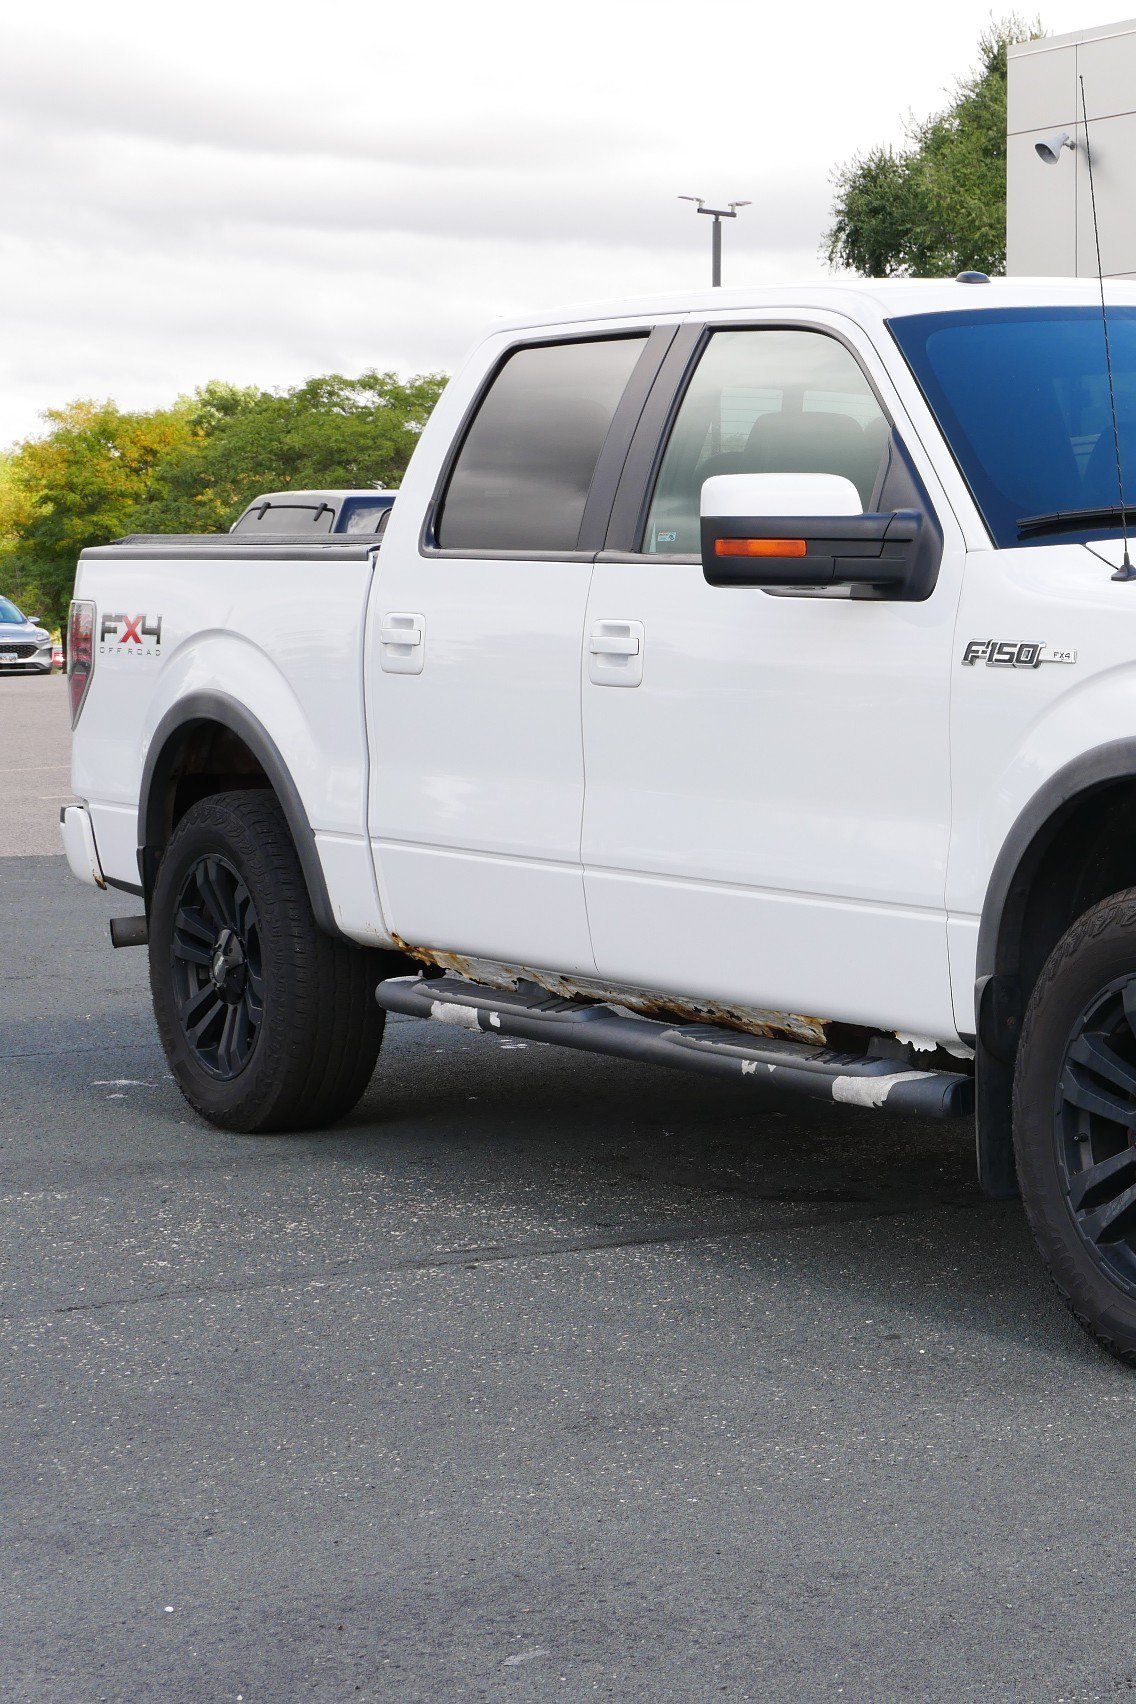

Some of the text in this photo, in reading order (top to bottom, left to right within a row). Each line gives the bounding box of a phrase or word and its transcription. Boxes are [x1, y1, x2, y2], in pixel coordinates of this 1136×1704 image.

[100, 613, 162, 645] FX4
[128, 648, 161, 656] ROAD
[961, 639, 1071, 668] F-150 FX4
